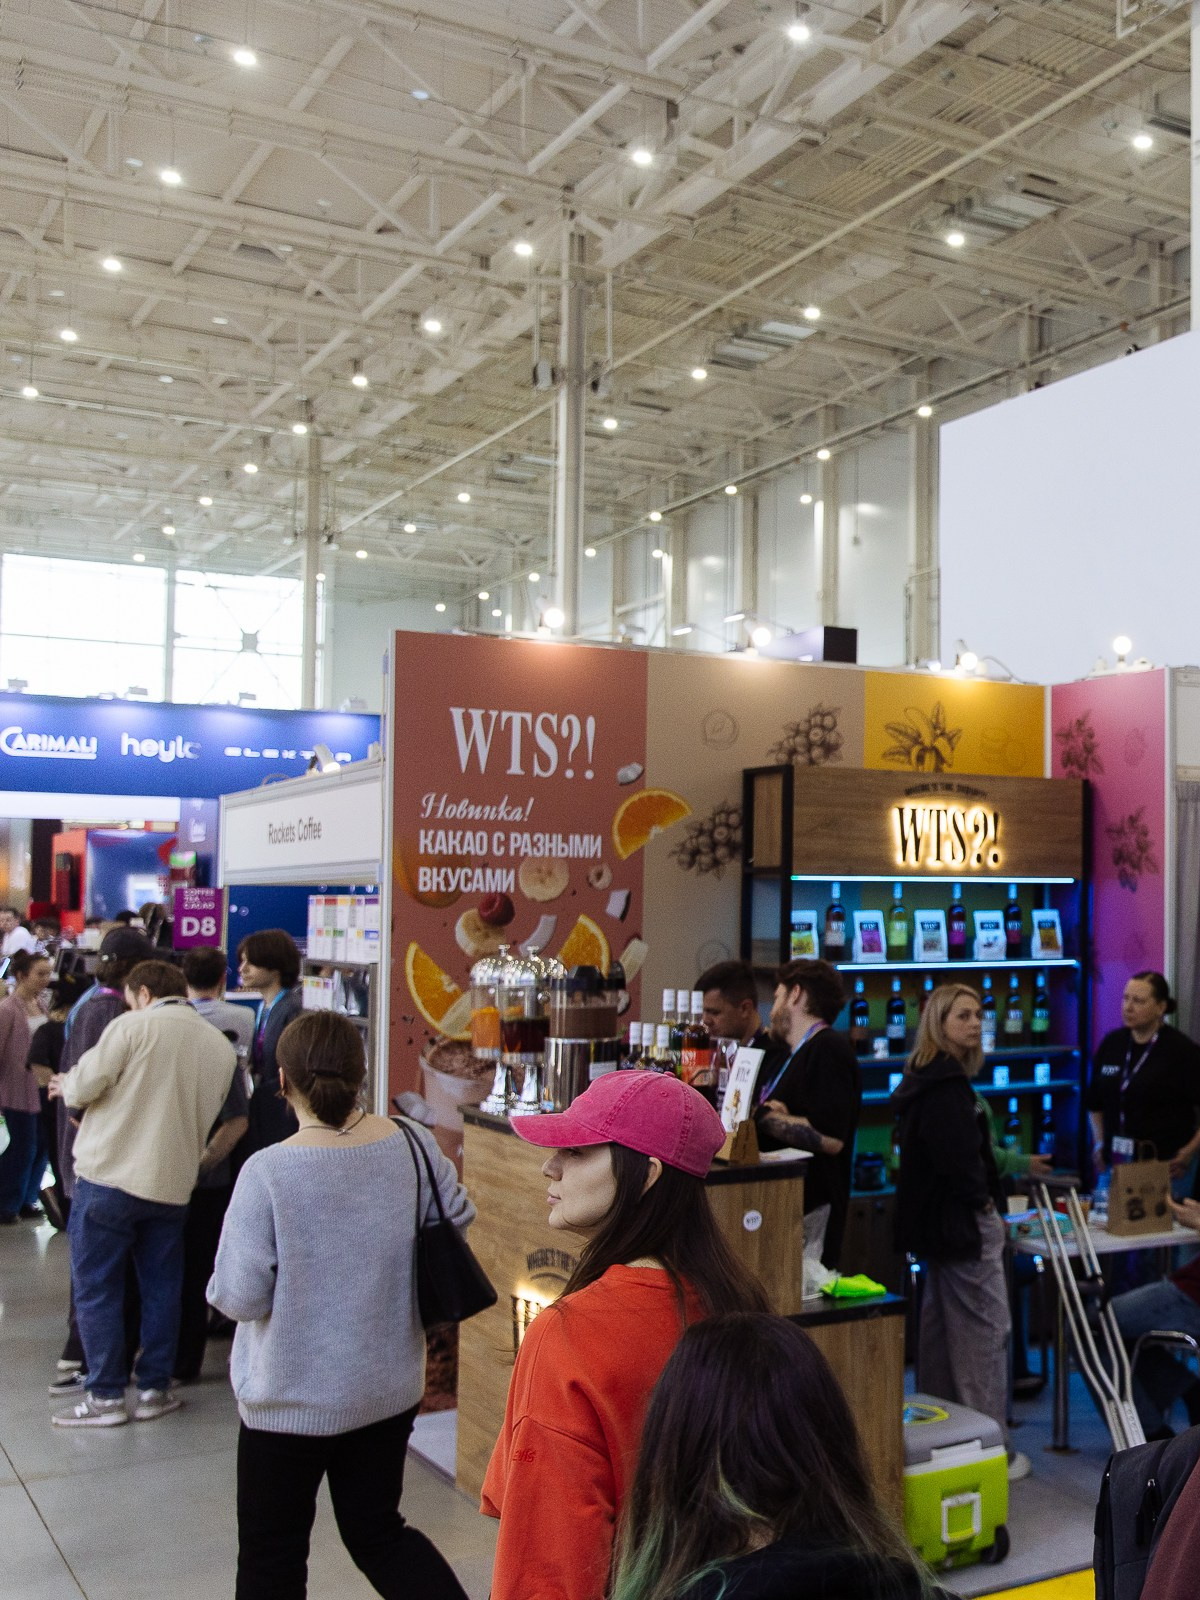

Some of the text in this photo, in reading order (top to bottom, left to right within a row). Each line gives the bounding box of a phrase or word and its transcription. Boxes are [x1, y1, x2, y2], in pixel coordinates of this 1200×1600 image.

[450, 707, 595, 779] WTS?!
[420, 792, 535, 823] Новинка!
[268, 816, 322, 844] Rockets Coffee
[418, 829, 602, 859] КАКАО С РАЗНЫМИ
[893, 803, 1001, 865] WTS?!
[418, 867, 515, 893] ВКУСАМИ
[181, 916, 217, 937] D8
